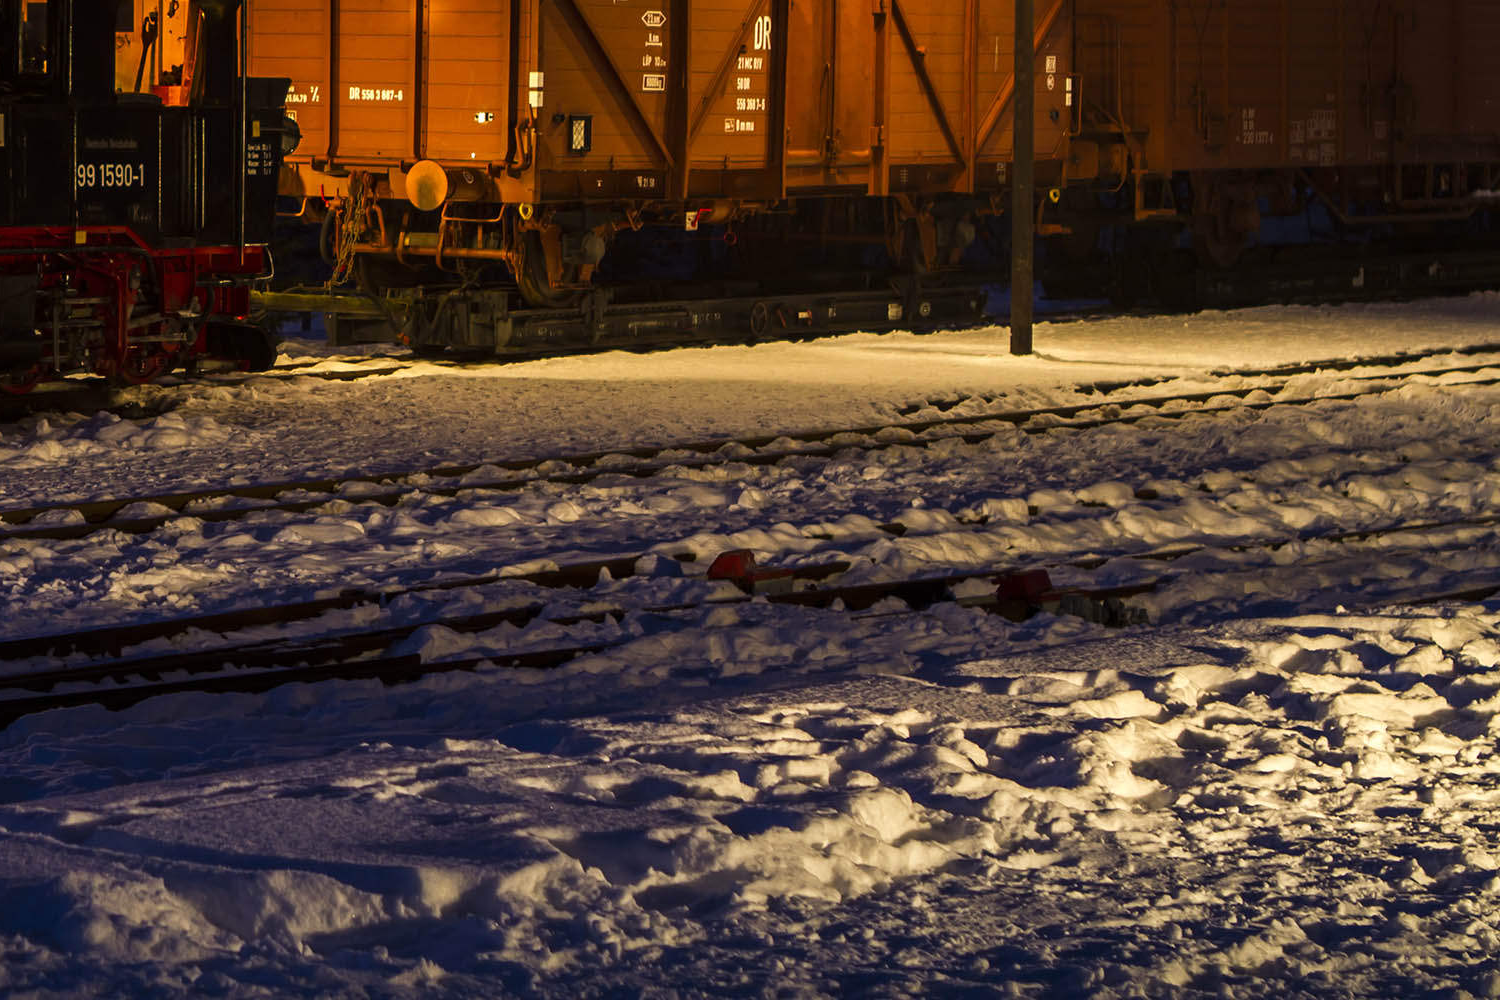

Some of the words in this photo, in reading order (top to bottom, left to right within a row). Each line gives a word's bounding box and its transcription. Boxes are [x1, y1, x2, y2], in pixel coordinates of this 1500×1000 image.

[754, 15, 772, 50] DR
[349, 87, 360, 100] DR
[77, 163, 96, 188] 99
[99, 163, 145, 188] 1590-1
